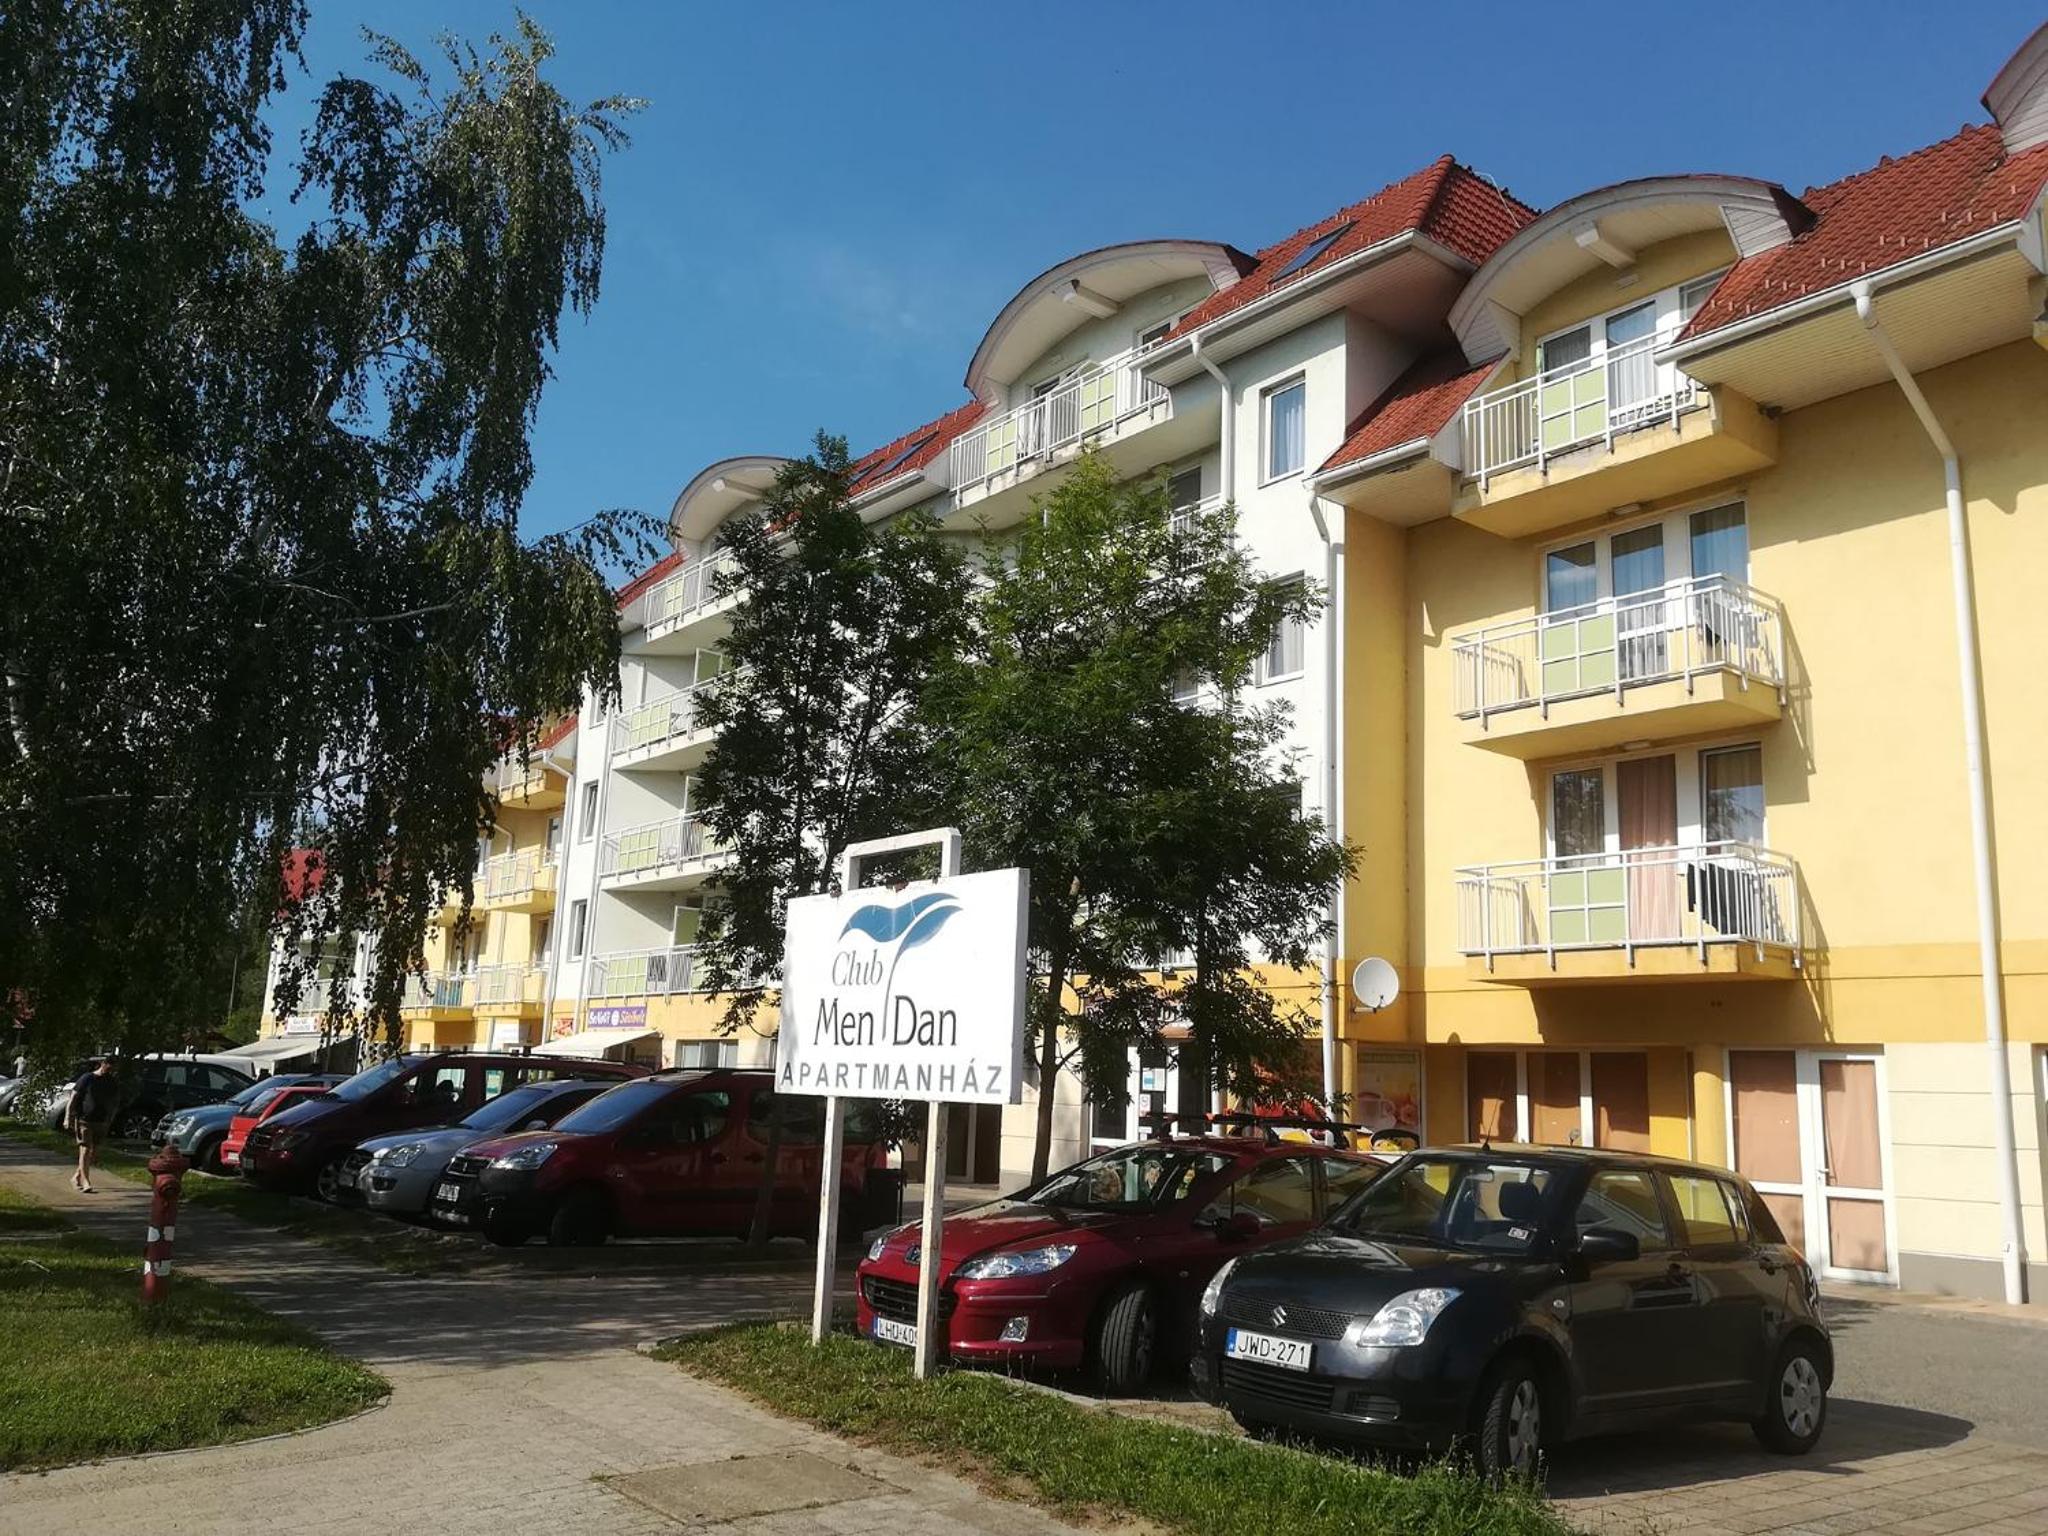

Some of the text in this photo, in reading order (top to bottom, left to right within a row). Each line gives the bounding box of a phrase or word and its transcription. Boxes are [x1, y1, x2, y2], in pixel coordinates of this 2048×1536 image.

[832, 949, 883, 986] Club
[813, 995, 957, 1046] Men Dan
[781, 1058, 1002, 1094] APARTMANHÁZ
[1239, 1334, 1306, 1365] JWD-271
